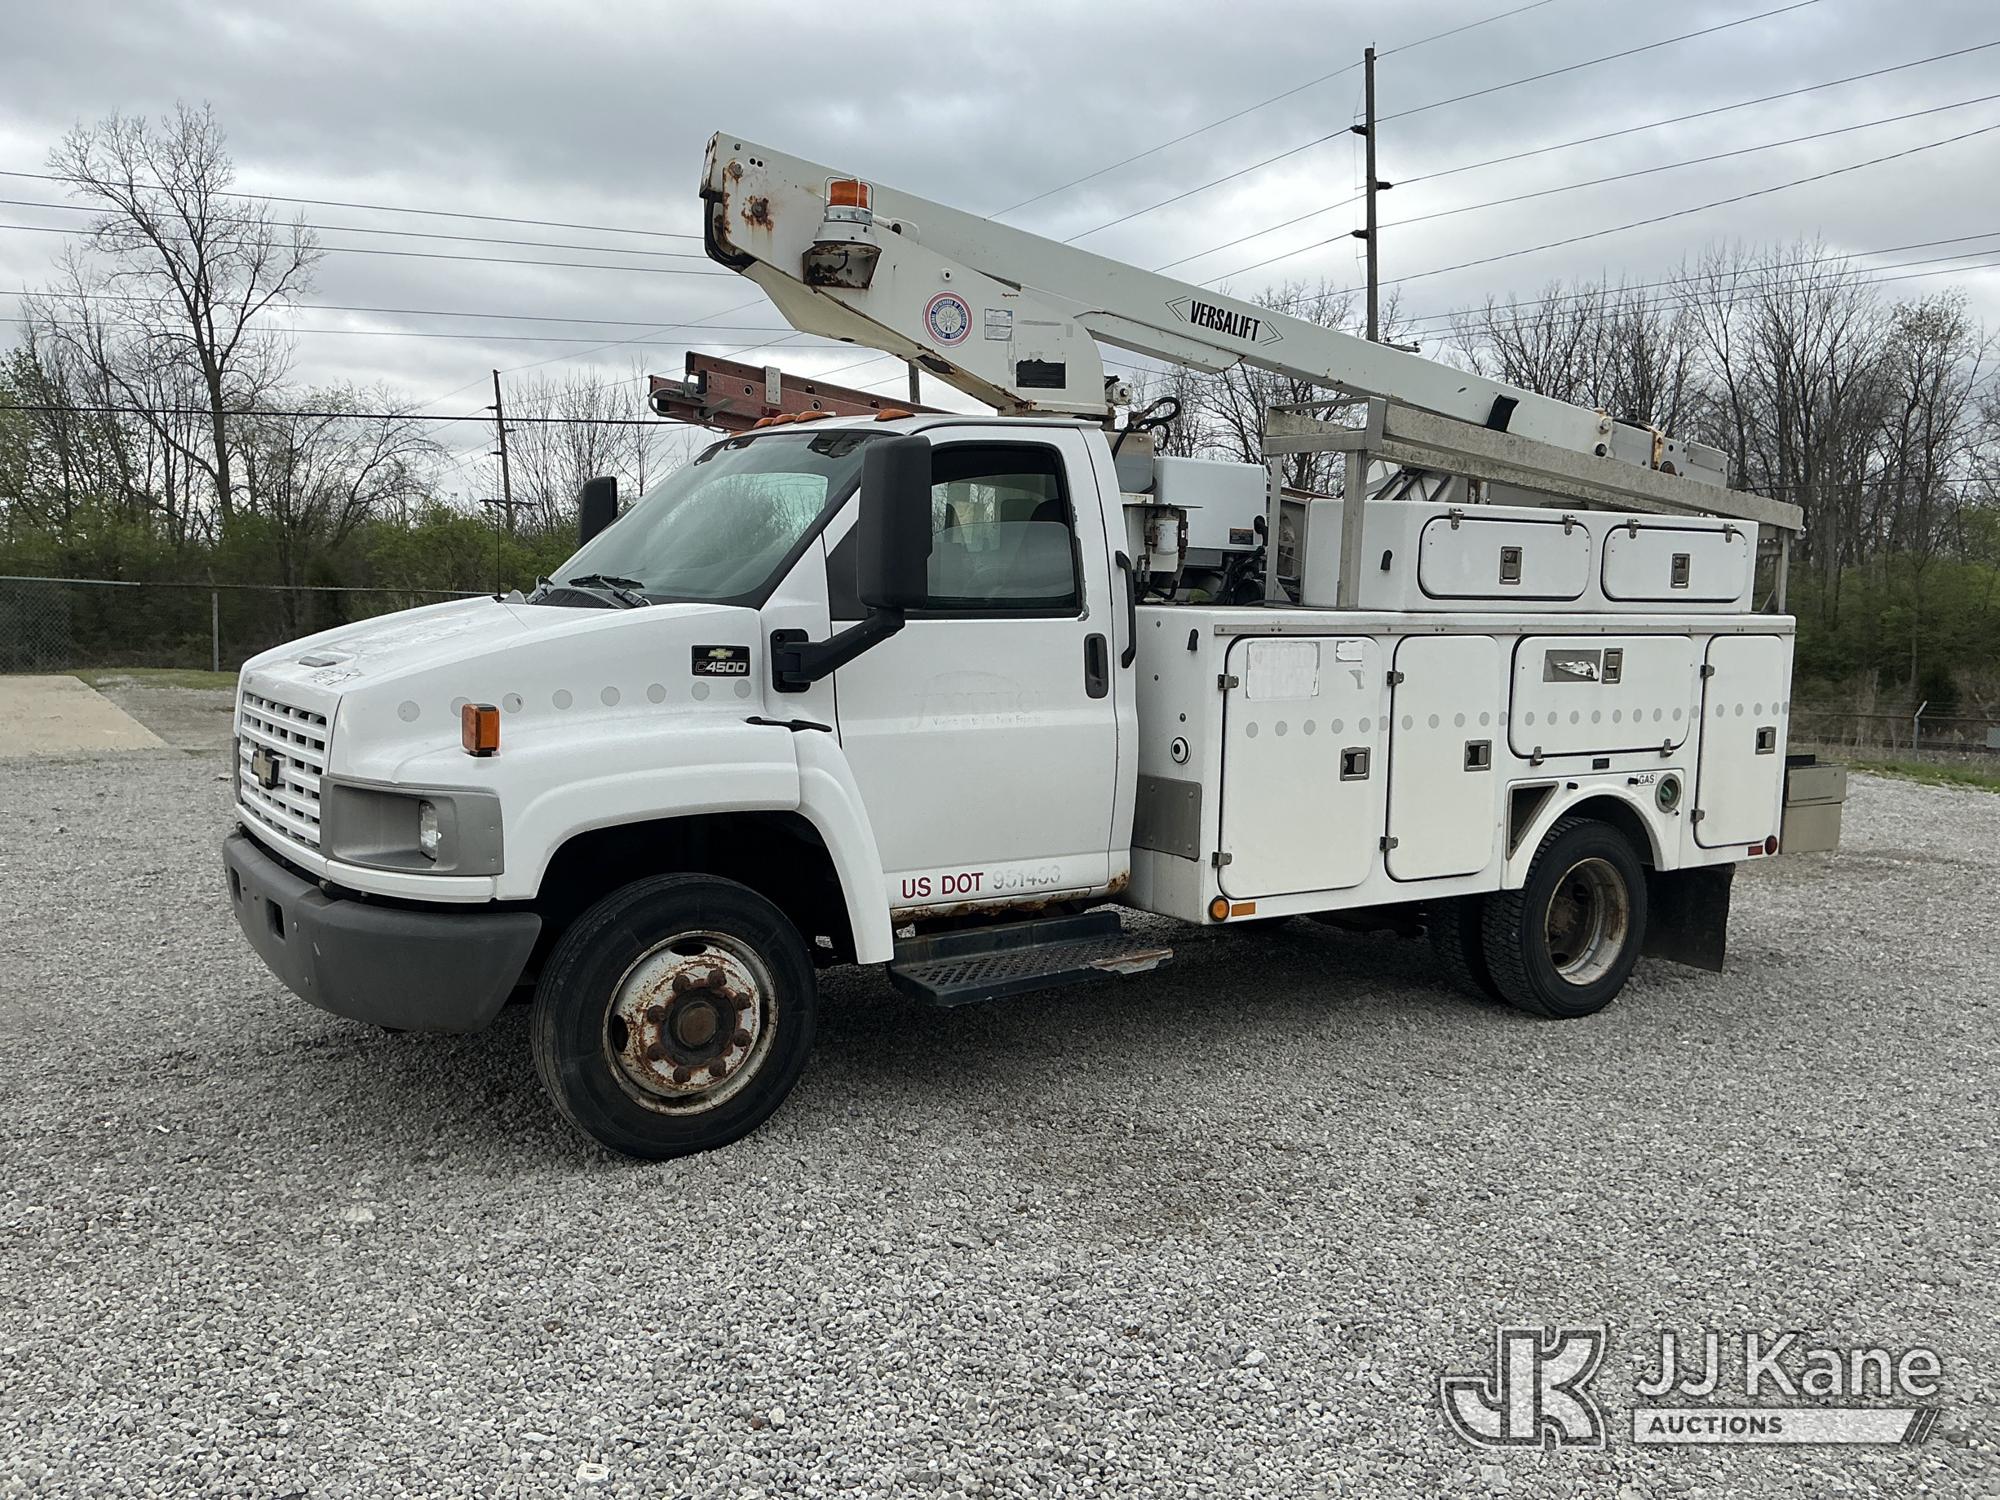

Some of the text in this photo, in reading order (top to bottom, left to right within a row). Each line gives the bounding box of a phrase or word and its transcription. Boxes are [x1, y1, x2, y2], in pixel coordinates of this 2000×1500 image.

[1190, 300, 1261, 341] VERSALIFT
[695, 661, 747, 673] C4500
[1639, 774, 1655, 785] GAS
[902, 876, 931, 899] US
[941, 872, 984, 895] DOT
